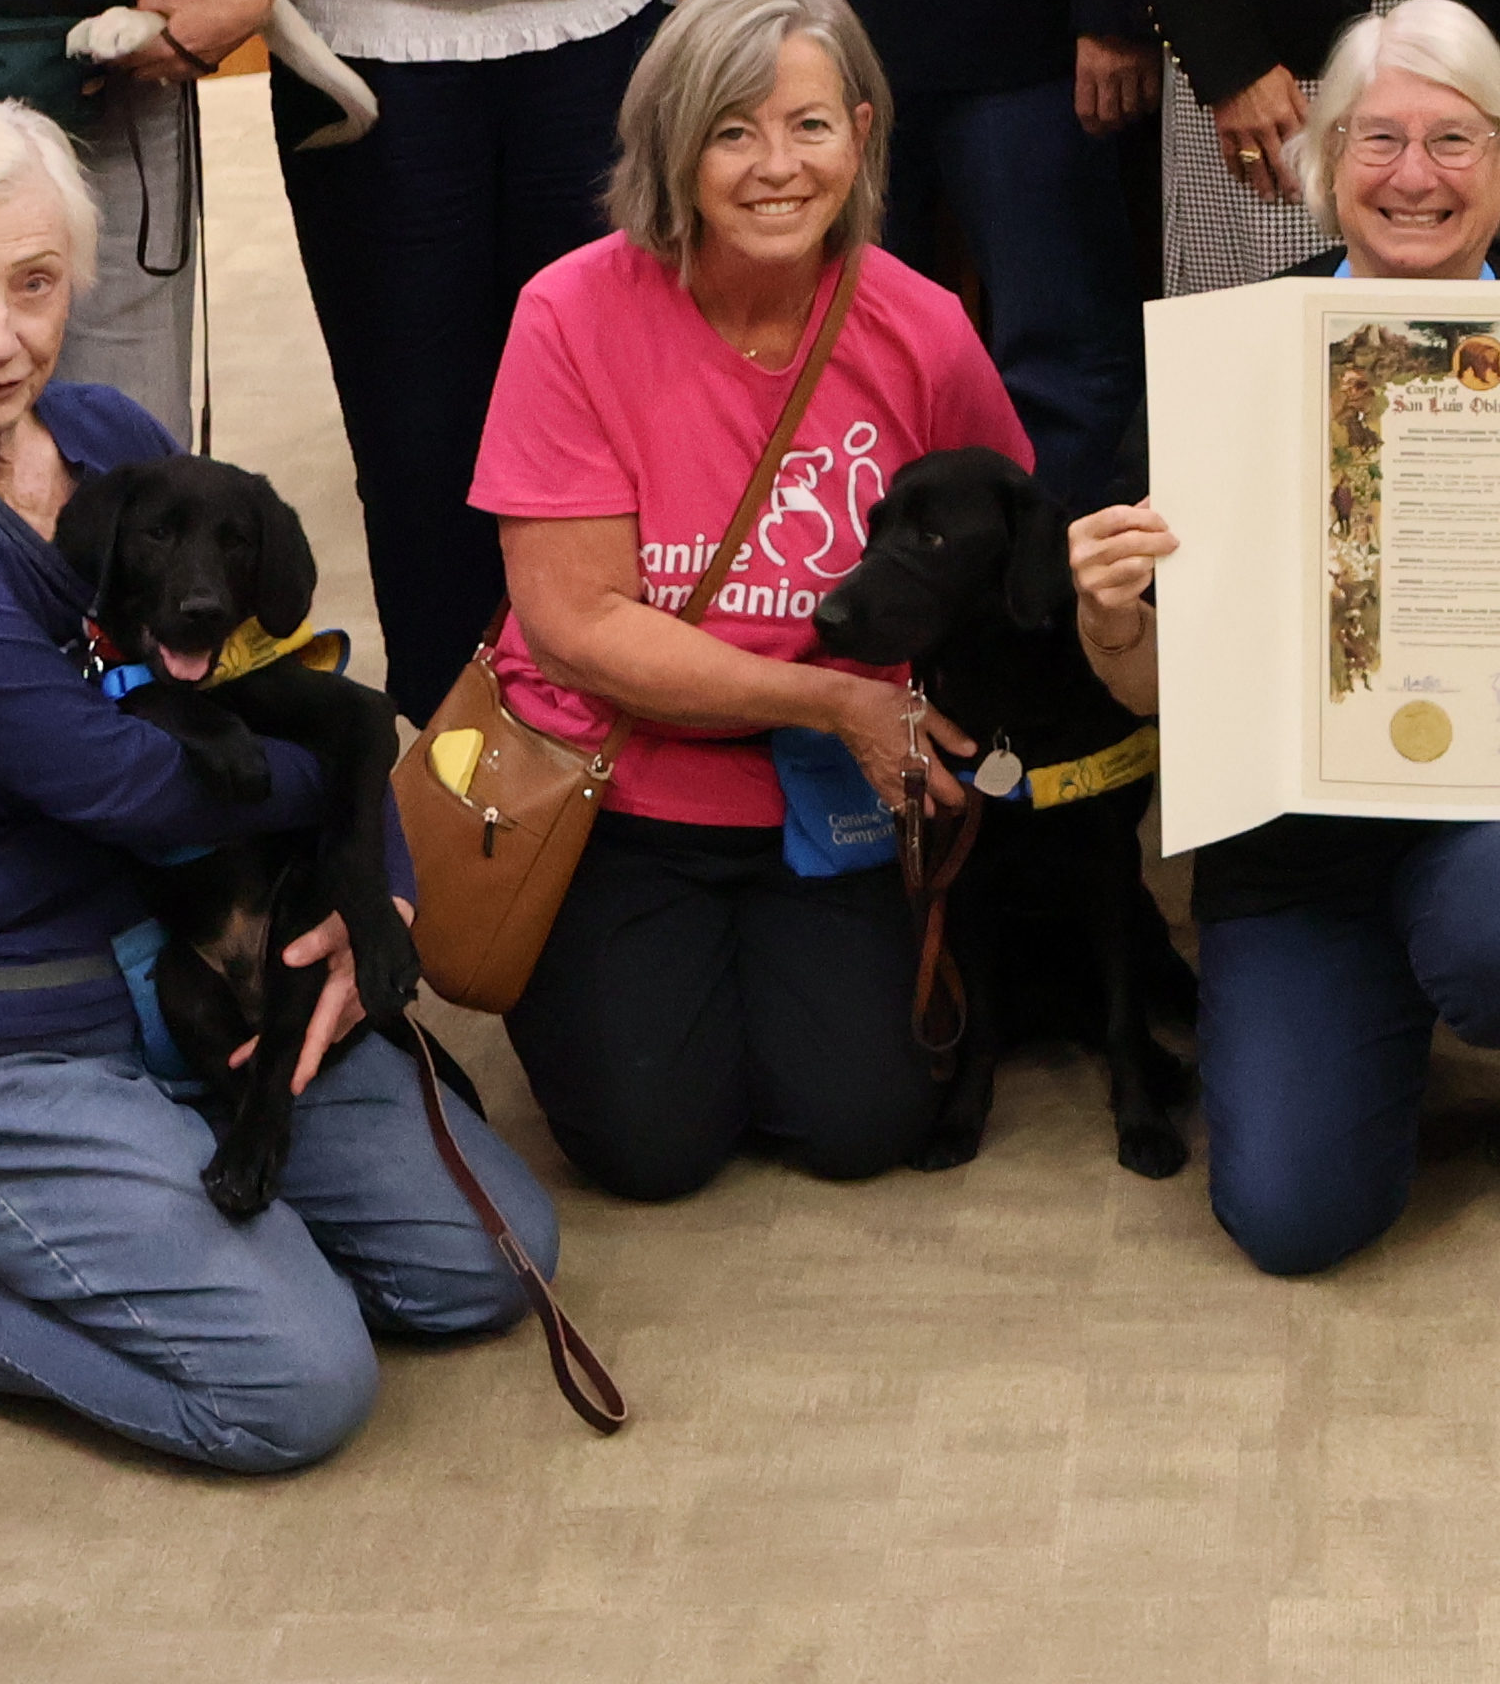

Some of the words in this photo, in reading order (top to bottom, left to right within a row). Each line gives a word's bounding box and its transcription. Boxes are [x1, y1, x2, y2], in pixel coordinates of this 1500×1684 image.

[1405, 383, 1447, 399] County
[1448, 384, 1460, 395] of
[1392, 394, 1424, 415] San
[1429, 396, 1464, 416] Luis
[639, 533, 753, 574] anine
